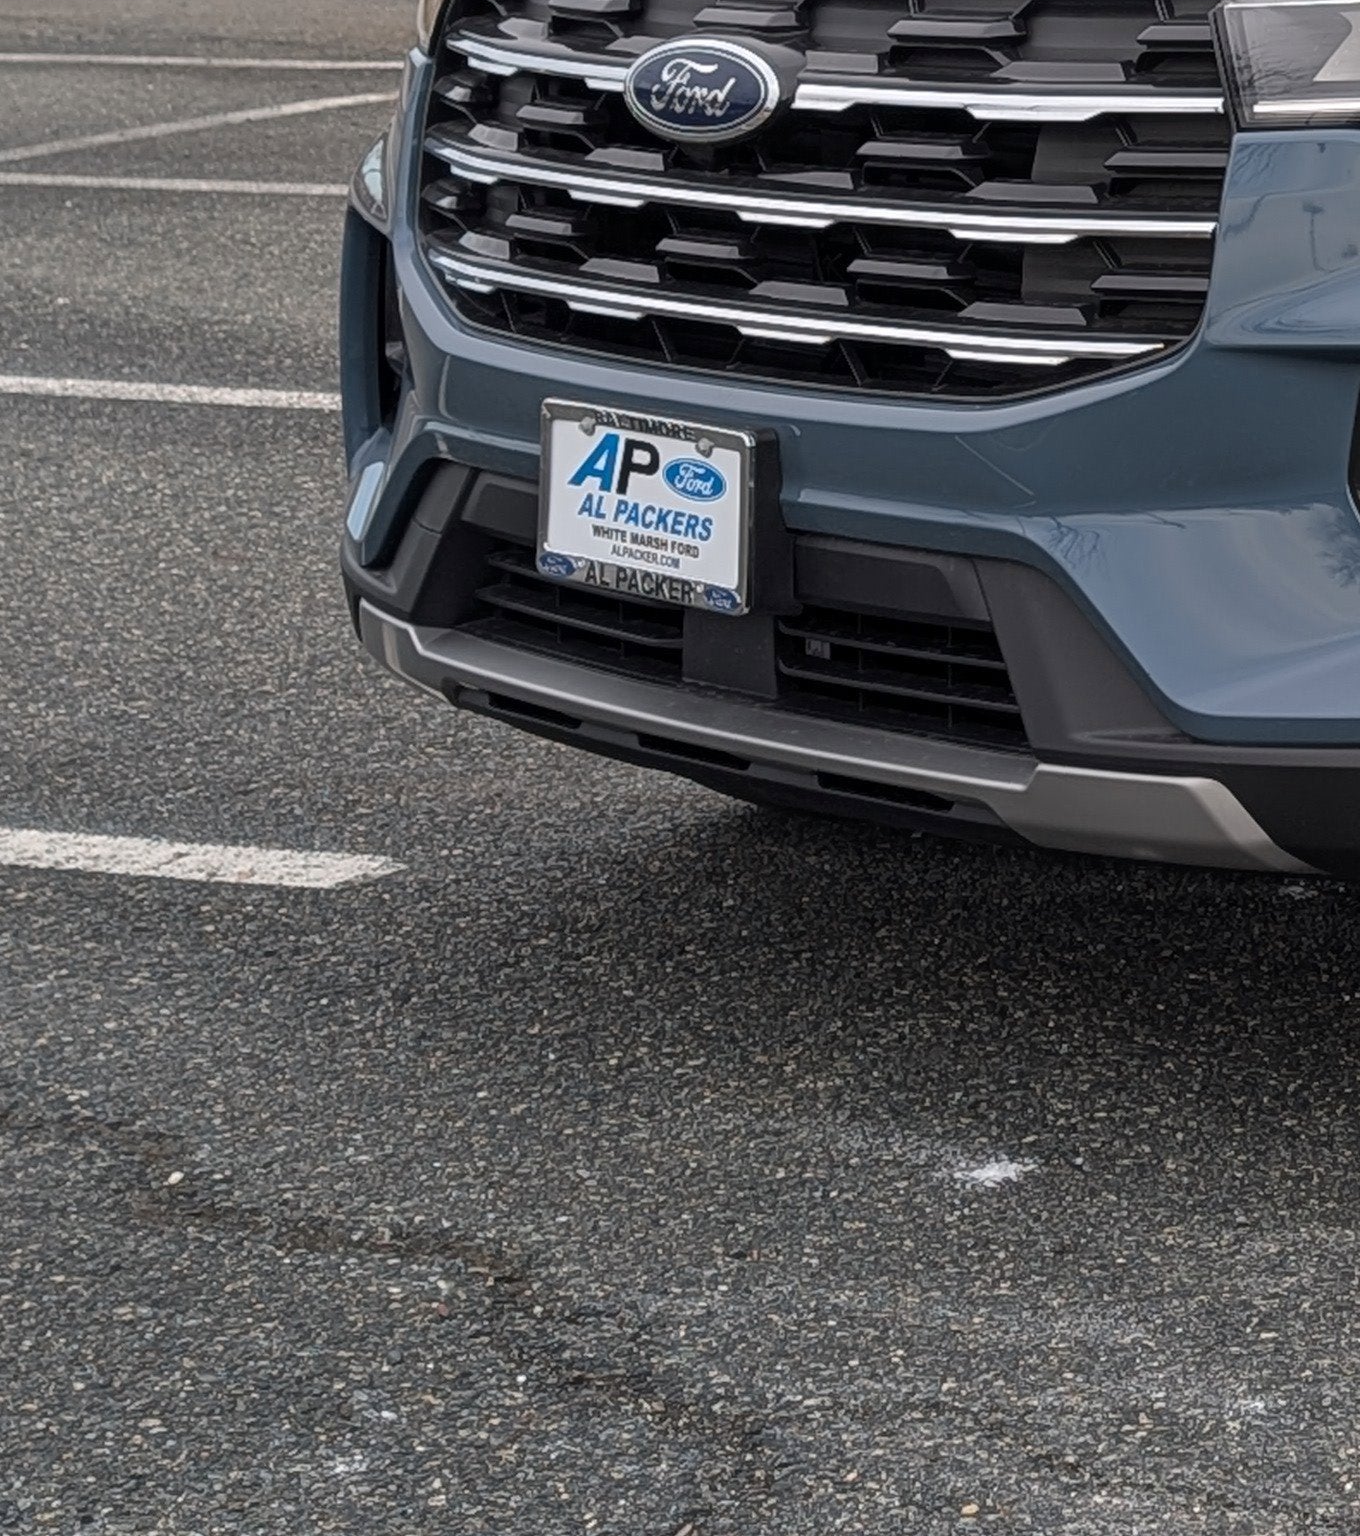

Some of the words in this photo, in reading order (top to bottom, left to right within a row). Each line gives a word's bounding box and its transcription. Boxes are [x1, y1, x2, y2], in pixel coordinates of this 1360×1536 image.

[651, 58, 737, 117] Ford
[567, 433, 660, 495] AP
[674, 462, 715, 496] Ford
[578, 492, 606, 519] AL
[613, 499, 714, 542] PACKERS
[592, 524, 628, 544] WHITE
[629, 533, 669, 552] MARSH
[670, 541, 700, 559] FORD
[611, 544, 681, 569] ALPACKER.COM
[585, 561, 609, 586] AL
[616, 568, 695, 604] PACKER
